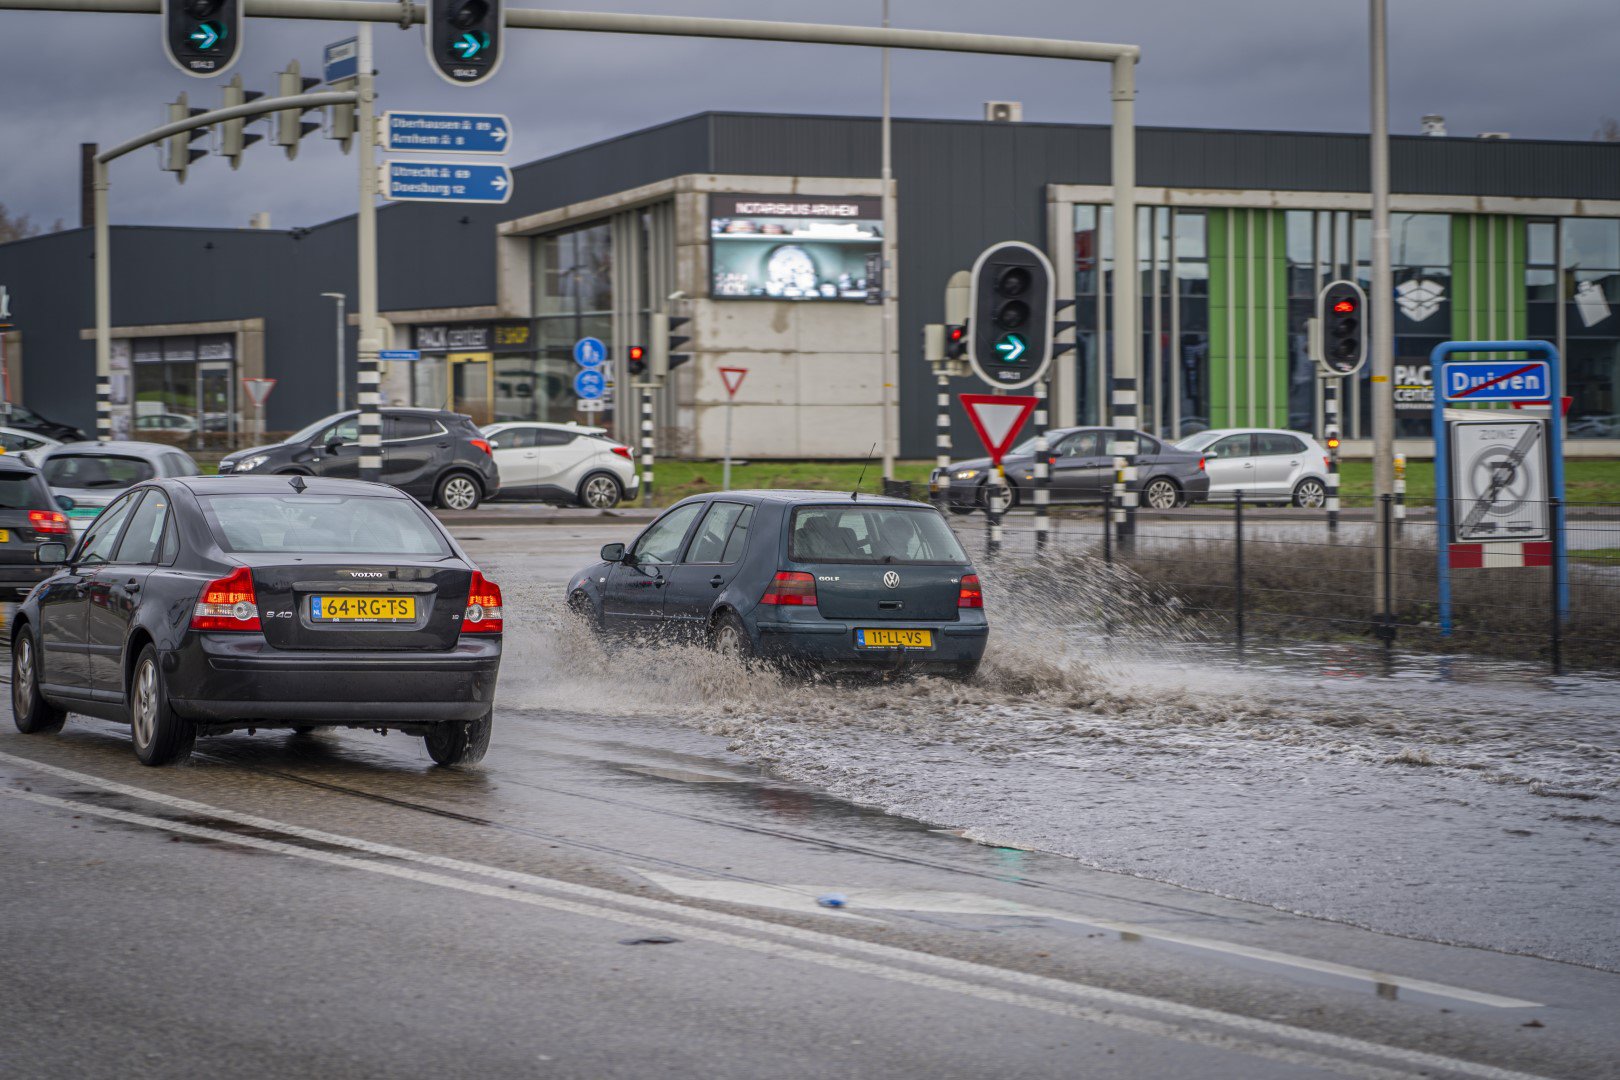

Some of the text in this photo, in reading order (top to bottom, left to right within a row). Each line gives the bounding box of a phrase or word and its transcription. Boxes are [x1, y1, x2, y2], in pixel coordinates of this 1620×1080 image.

[392, 118, 460, 130] Oberhausen
[392, 133, 440, 144] Arnhem
[392, 166, 440, 178] Utrecht
[392, 181, 451, 196] Doesburg
[811, 204, 859, 216] ARNHEM
[417, 327, 447, 348] PACK
[1394, 365, 1433, 386] PAC
[1452, 372, 1540, 391] Duiven
[327, 599, 408, 616] 64-RG-TS
[872, 631, 922, 645] 11-LL-VS
